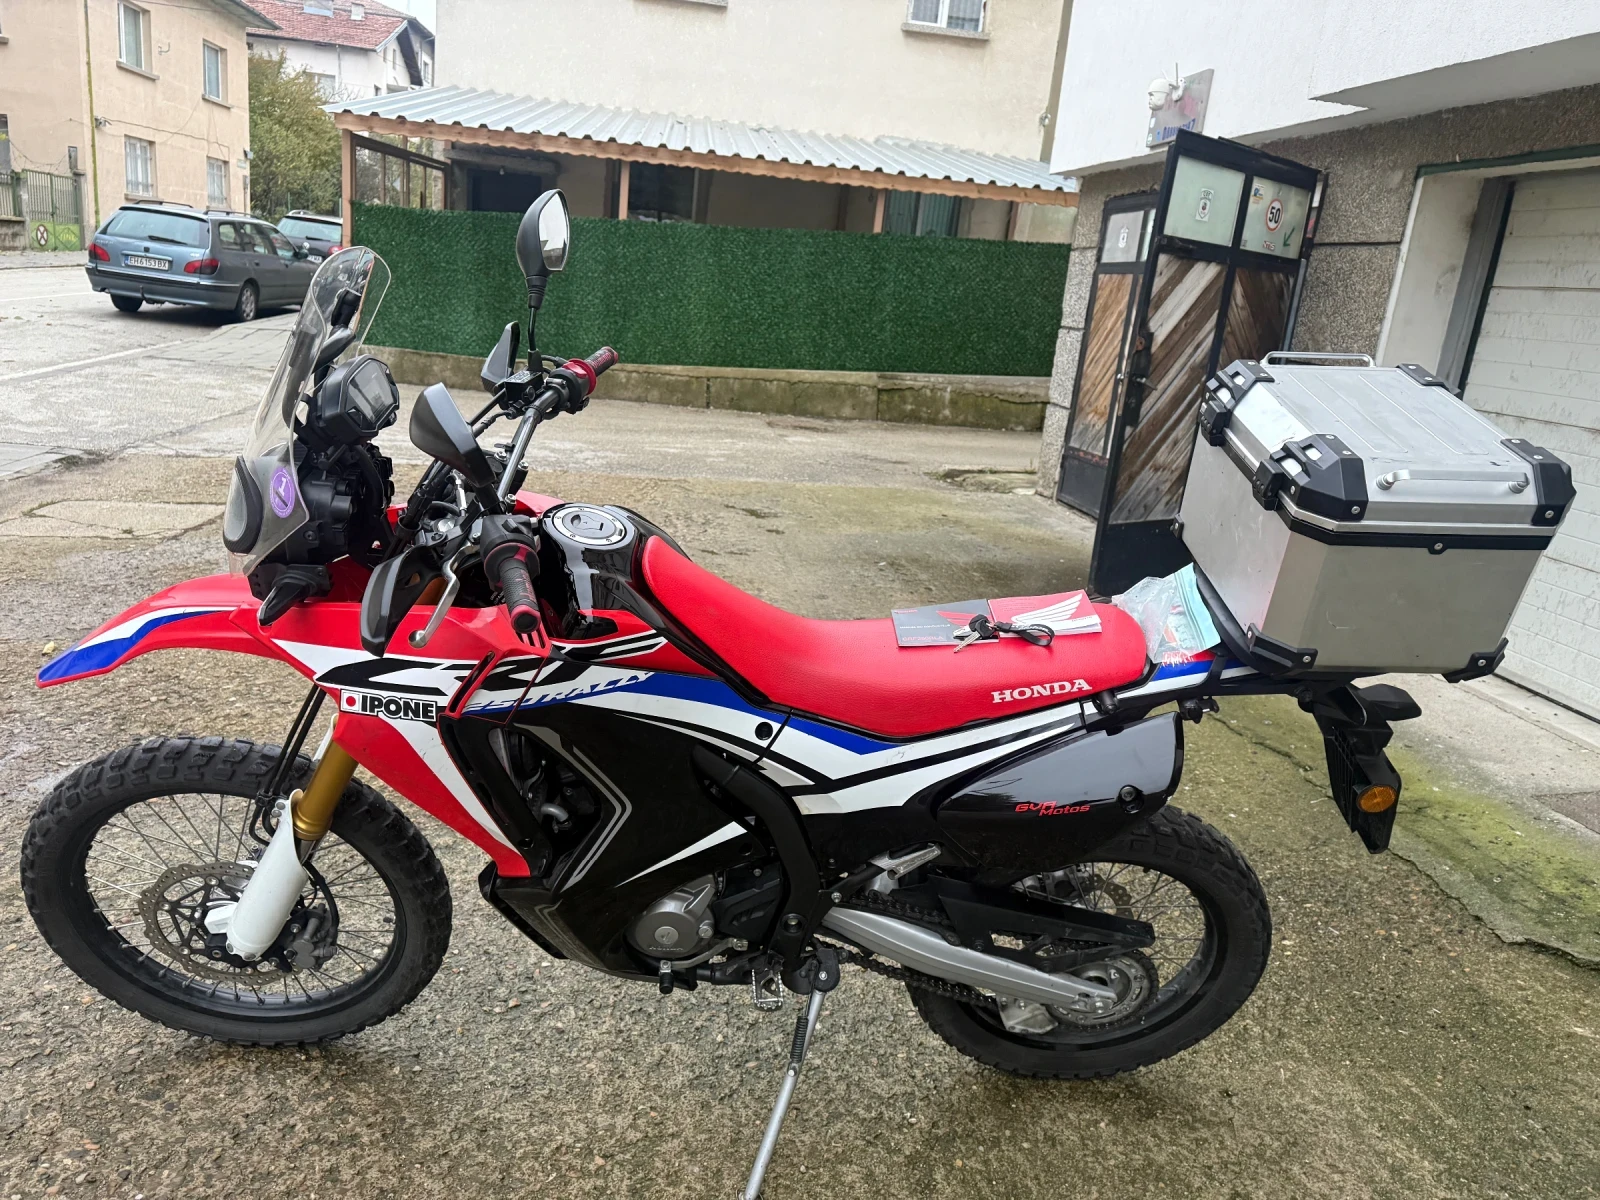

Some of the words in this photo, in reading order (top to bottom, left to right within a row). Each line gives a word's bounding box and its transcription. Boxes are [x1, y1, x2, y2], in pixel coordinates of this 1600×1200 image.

[1268, 206, 1281, 224] 50
[990, 678, 1093, 704] HONDA
[360, 693, 436, 720] IPONE
